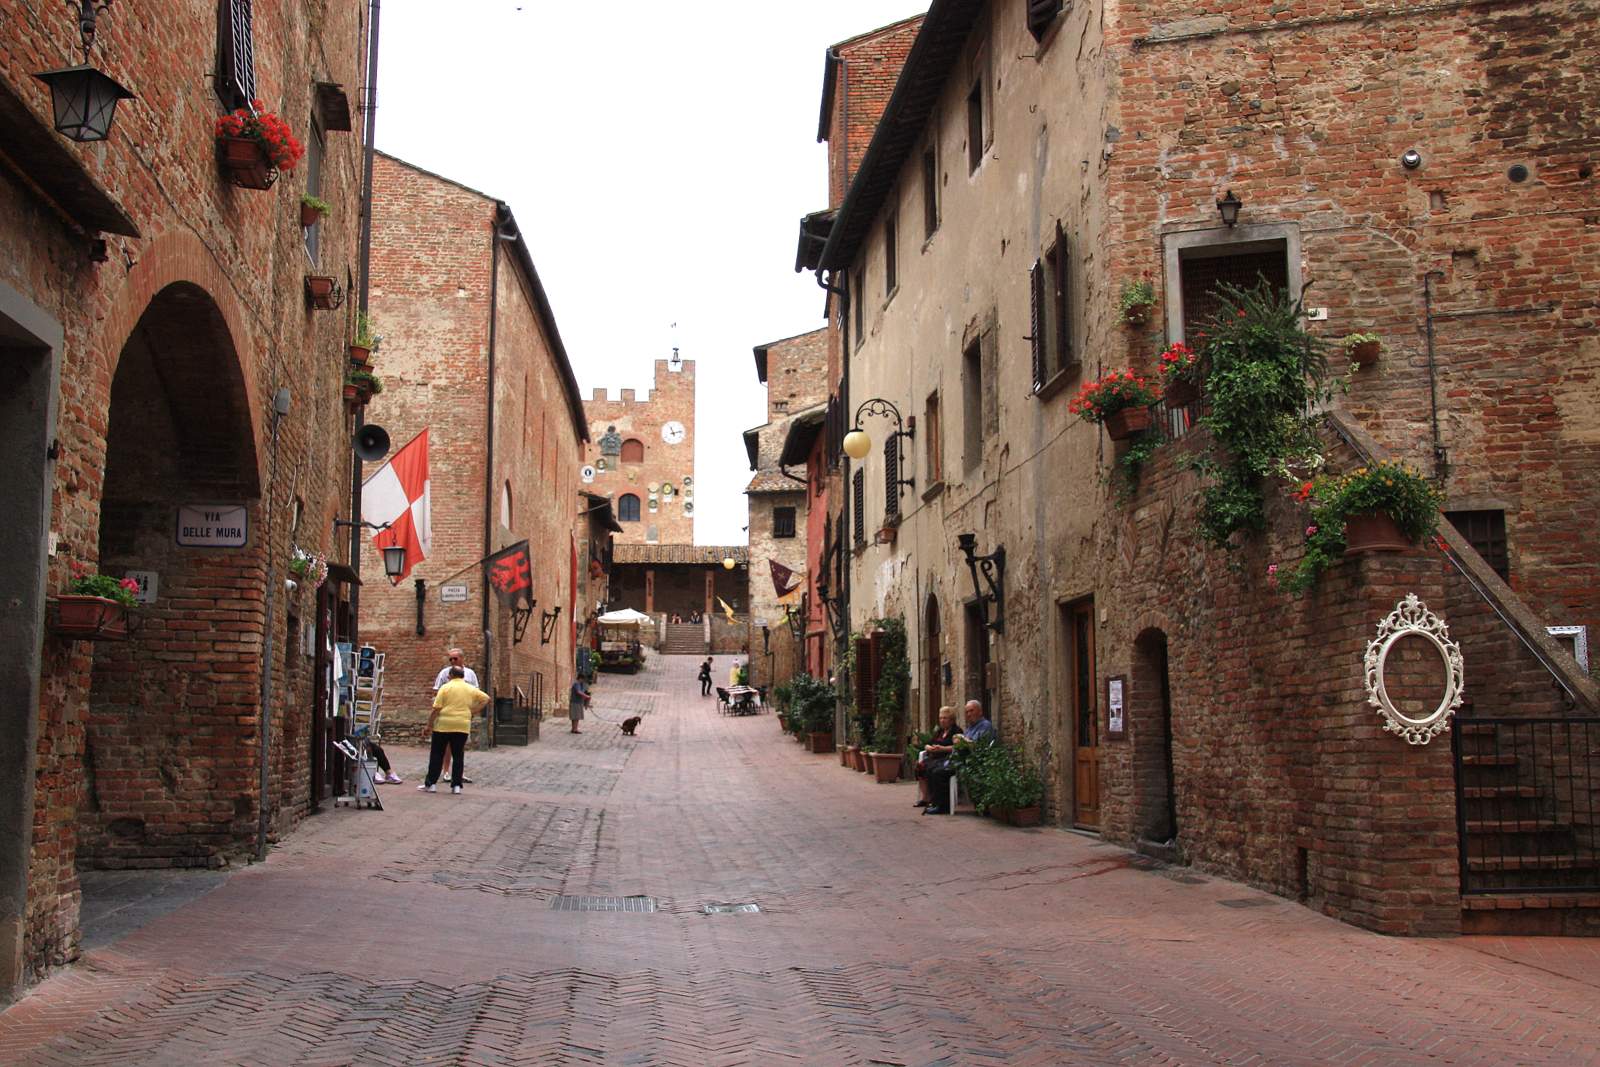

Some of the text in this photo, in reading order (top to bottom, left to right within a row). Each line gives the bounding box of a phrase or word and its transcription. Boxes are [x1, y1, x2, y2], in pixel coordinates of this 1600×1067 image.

[205, 512, 221, 522] VIA
[183, 527, 242, 538] DELLE MURA
